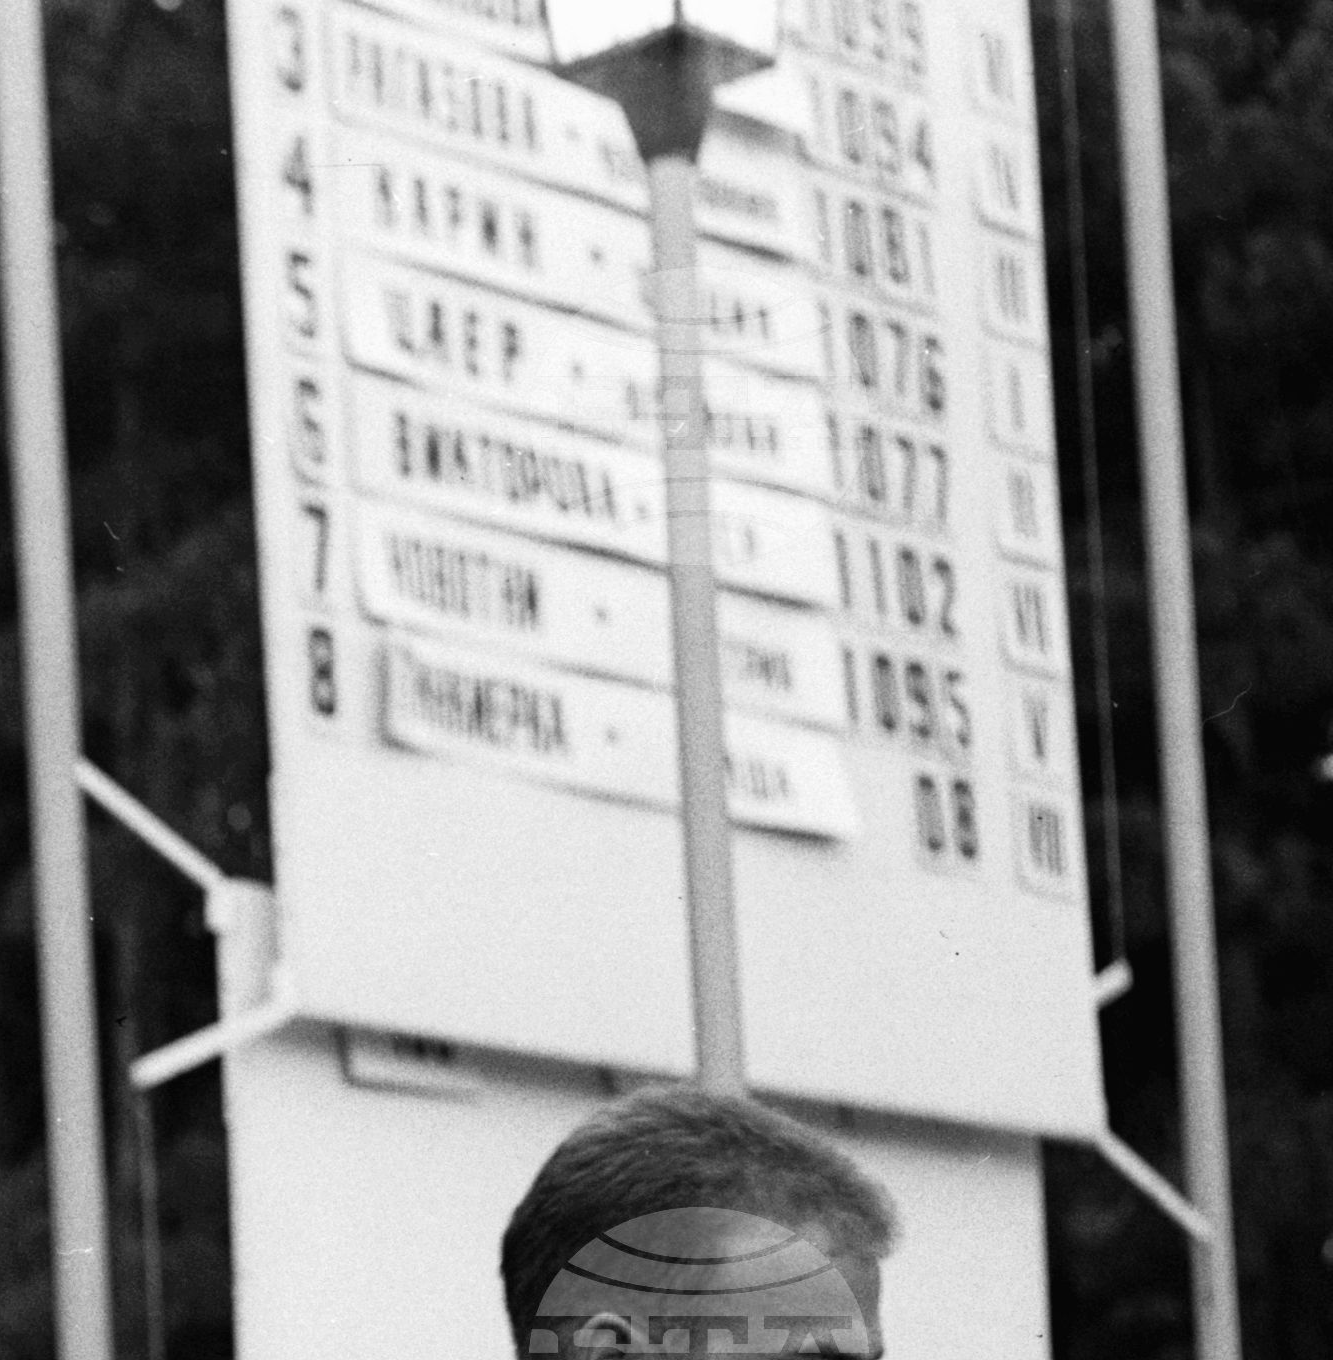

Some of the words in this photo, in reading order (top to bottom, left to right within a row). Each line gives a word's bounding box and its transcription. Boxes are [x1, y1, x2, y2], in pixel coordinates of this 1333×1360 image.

[281, 135, 314, 217] 4
[288, 247, 318, 340] 5
[827, 412, 949, 526] 1077
[302, 501, 328, 593] 7
[835, 531, 957, 638] 1102
[309, 626, 336, 716] 8
[913, 773, 979, 860] 08
